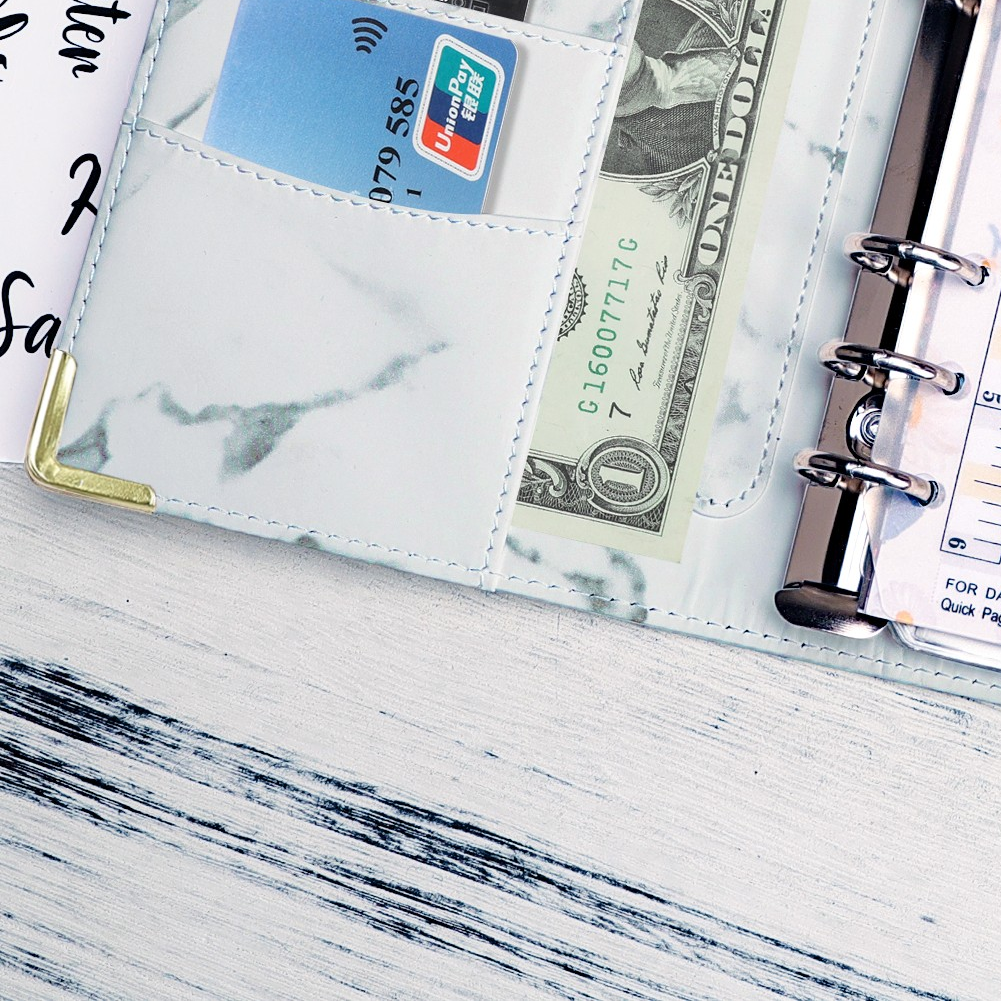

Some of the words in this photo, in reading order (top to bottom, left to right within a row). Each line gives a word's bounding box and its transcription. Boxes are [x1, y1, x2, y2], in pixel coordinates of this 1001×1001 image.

[385, 76, 420, 138] 585
[434, 58, 475, 153] UnionPay
[460, 71, 485, 122] 银联
[712, 70, 732, 138] WASHINGTON
[698, 162, 738, 266] ONE
[609, 401, 632, 419] 7
[982, 390, 1001, 404] 5
[599, 461, 647, 493] 1
[948, 537, 967, 550] 6
[945, 578, 978, 596] FOR
[940, 597, 976, 617] Quick
